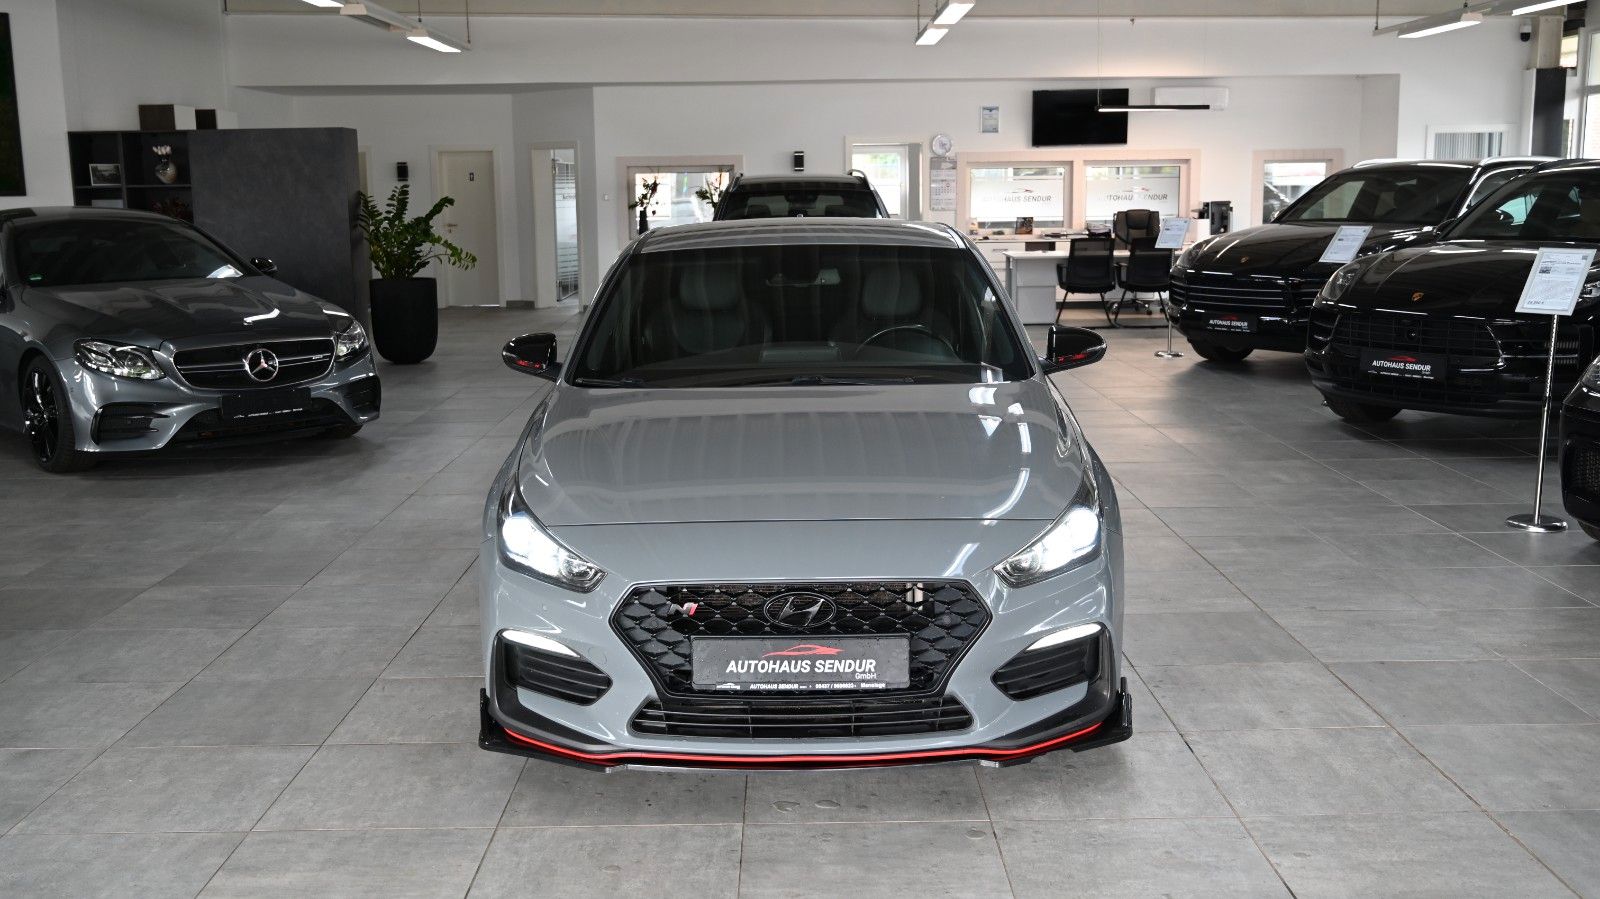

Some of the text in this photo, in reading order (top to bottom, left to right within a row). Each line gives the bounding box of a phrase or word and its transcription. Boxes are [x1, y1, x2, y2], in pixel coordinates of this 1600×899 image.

[1372, 360, 1432, 371] AUTOHAUS SENDUR
[725, 659, 876, 673] AUTOHAUS SENDUR
